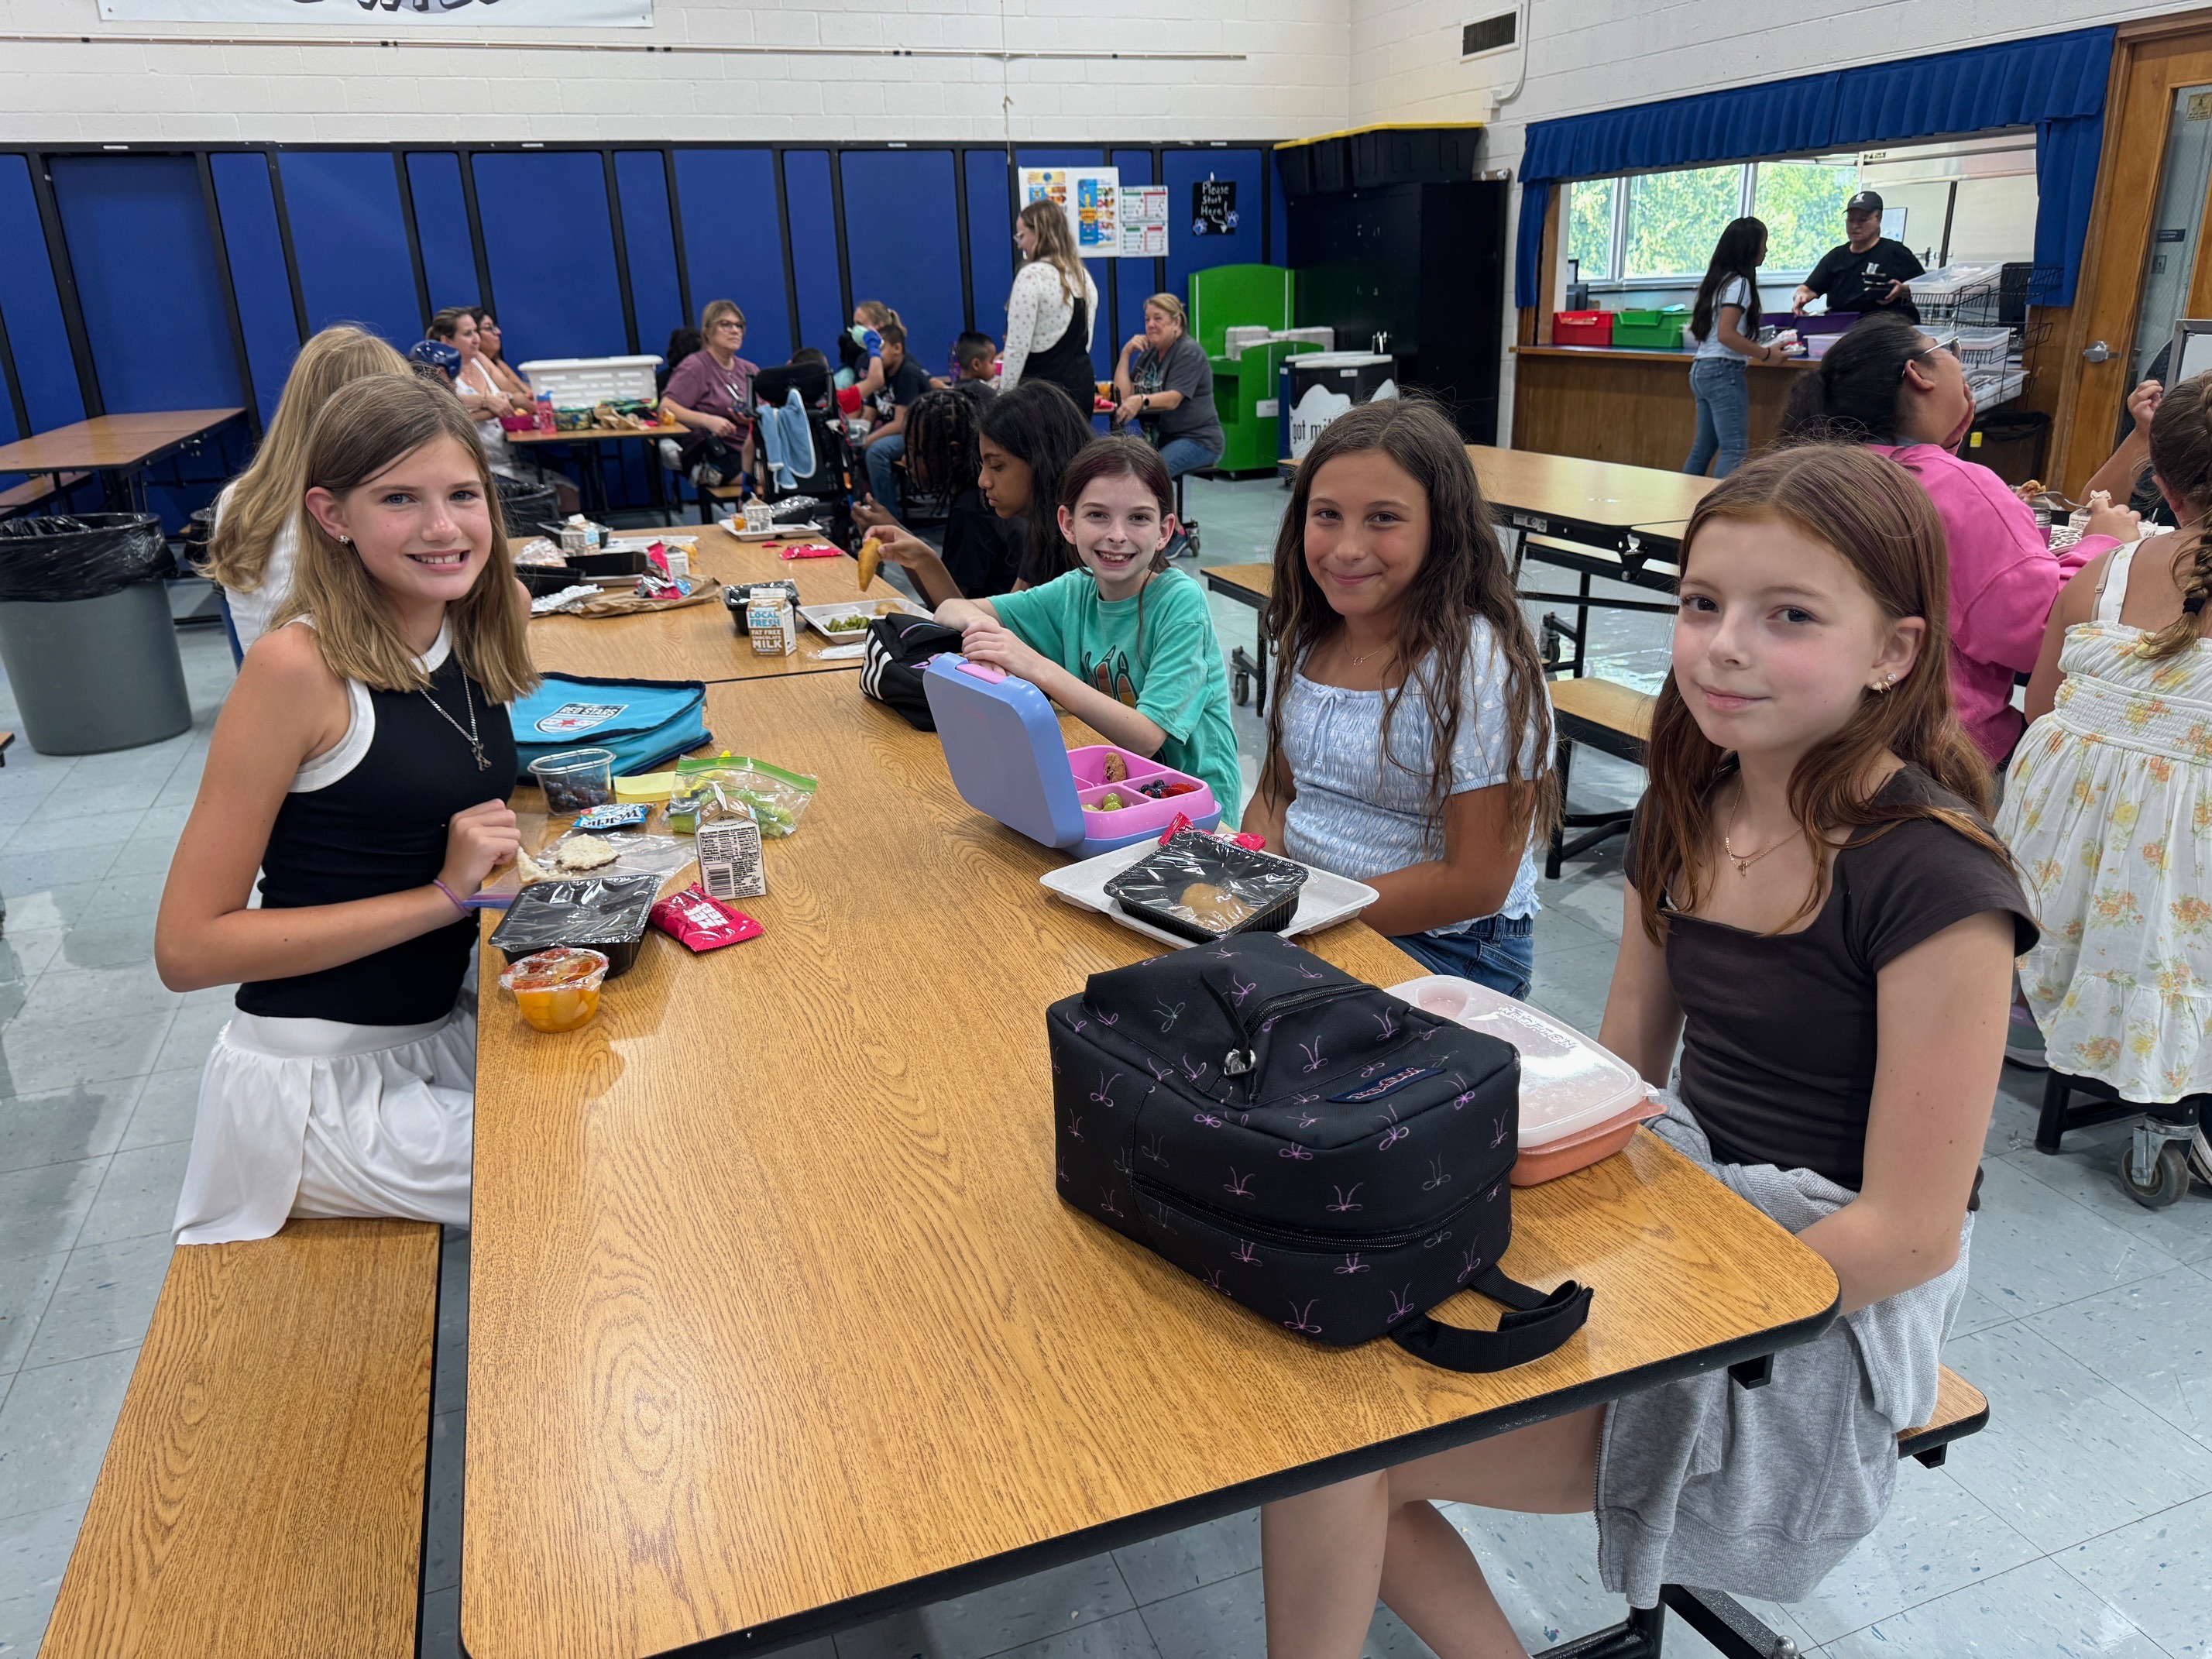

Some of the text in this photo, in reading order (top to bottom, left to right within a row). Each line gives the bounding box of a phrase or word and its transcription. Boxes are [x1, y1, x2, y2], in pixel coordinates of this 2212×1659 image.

[1202, 180, 1229, 195] Please
[1293, 420, 1306, 444] got
[750, 619, 781, 627] FRESH
[752, 640, 783, 649] MILK
[559, 706, 618, 716] RED STARS
